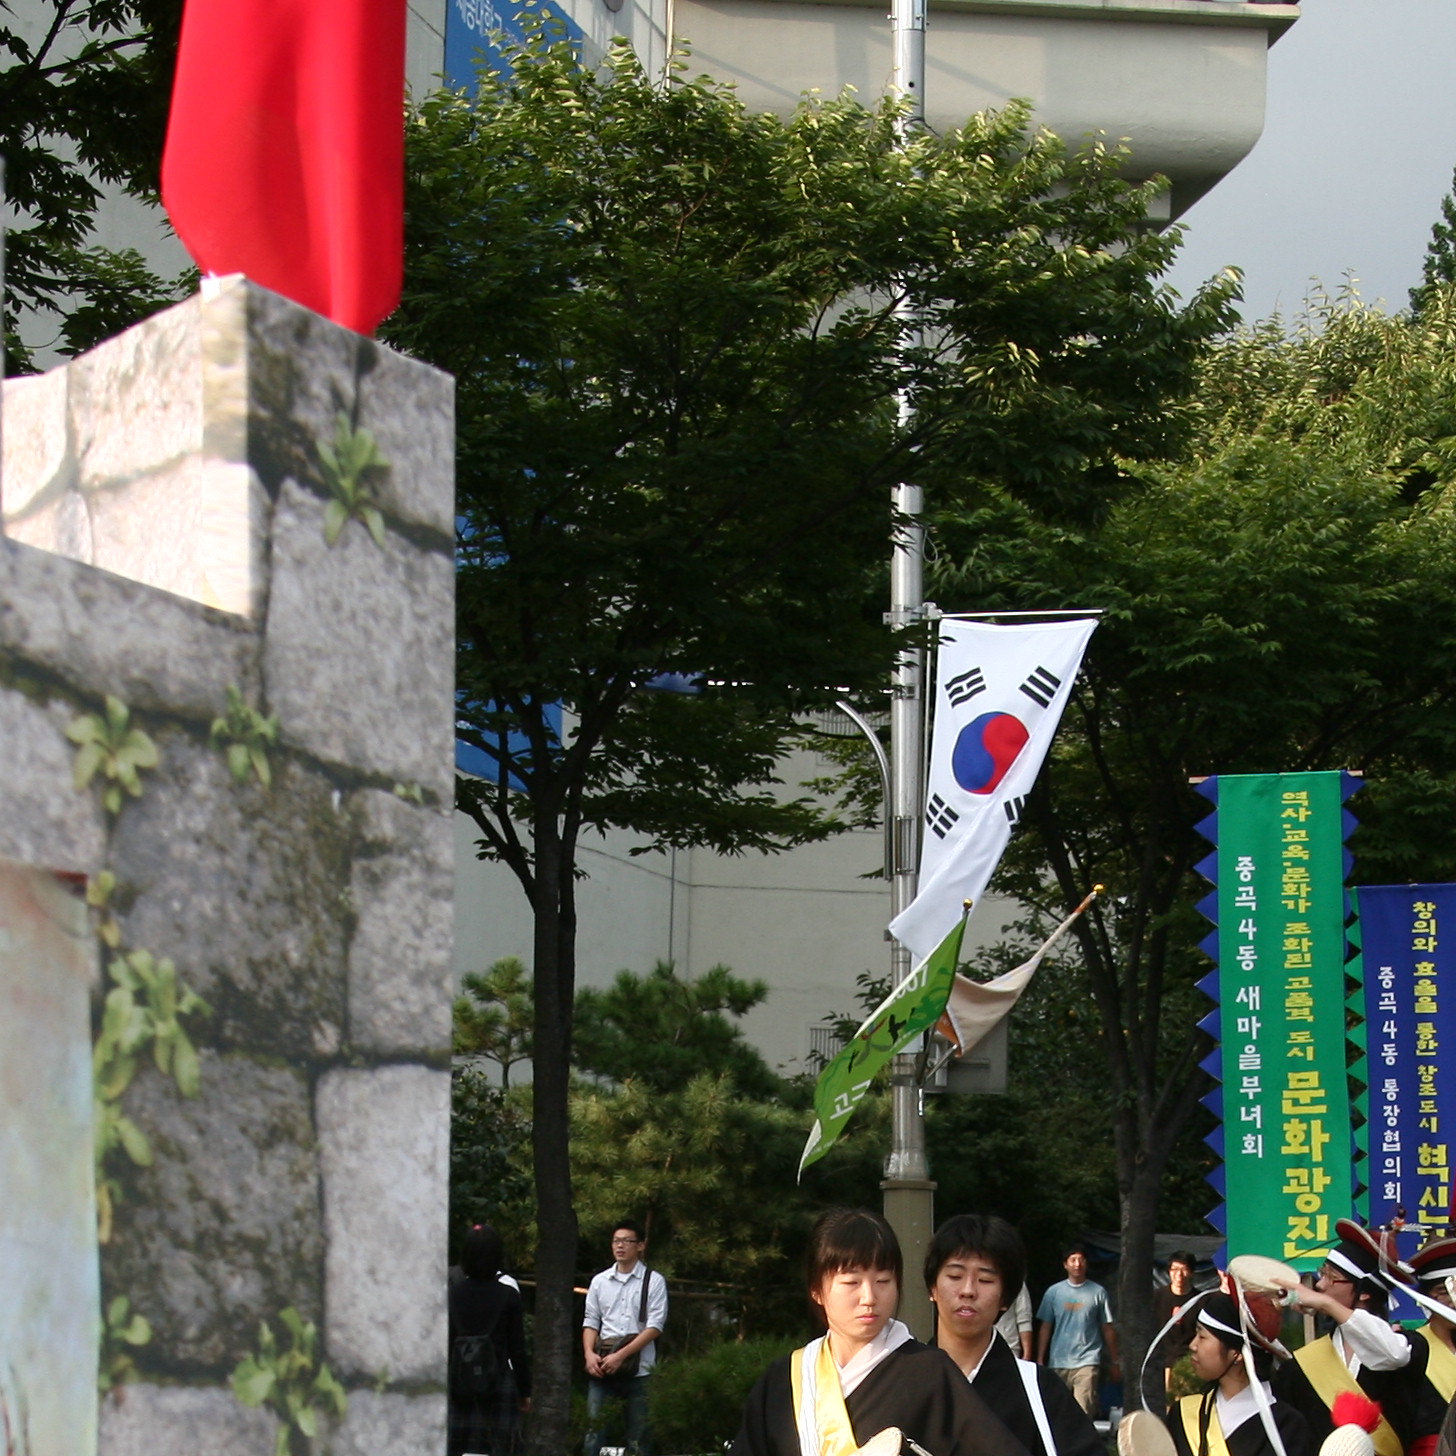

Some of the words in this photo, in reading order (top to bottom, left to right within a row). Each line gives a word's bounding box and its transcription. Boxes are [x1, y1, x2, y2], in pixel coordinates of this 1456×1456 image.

[1235, 856, 1257, 971] 중곡4동
[1411, 901, 1438, 953] 창의와
[1283, 922, 1313, 968] 조화된
[1284, 976, 1314, 1021] 고품격
[1378, 966, 1398, 1066] 중곡4동
[1413, 961, 1437, 1013] 효율을
[1287, 1031, 1314, 1061] 도시
[1416, 1022, 1438, 1056] 통한
[1236, 986, 1263, 1158] 새마을부녀회
[1417, 1065, 1438, 1133] 창조도시
[1281, 1071, 1331, 1258] 문화광진
[1381, 1079, 1400, 1203] 통장협의회
